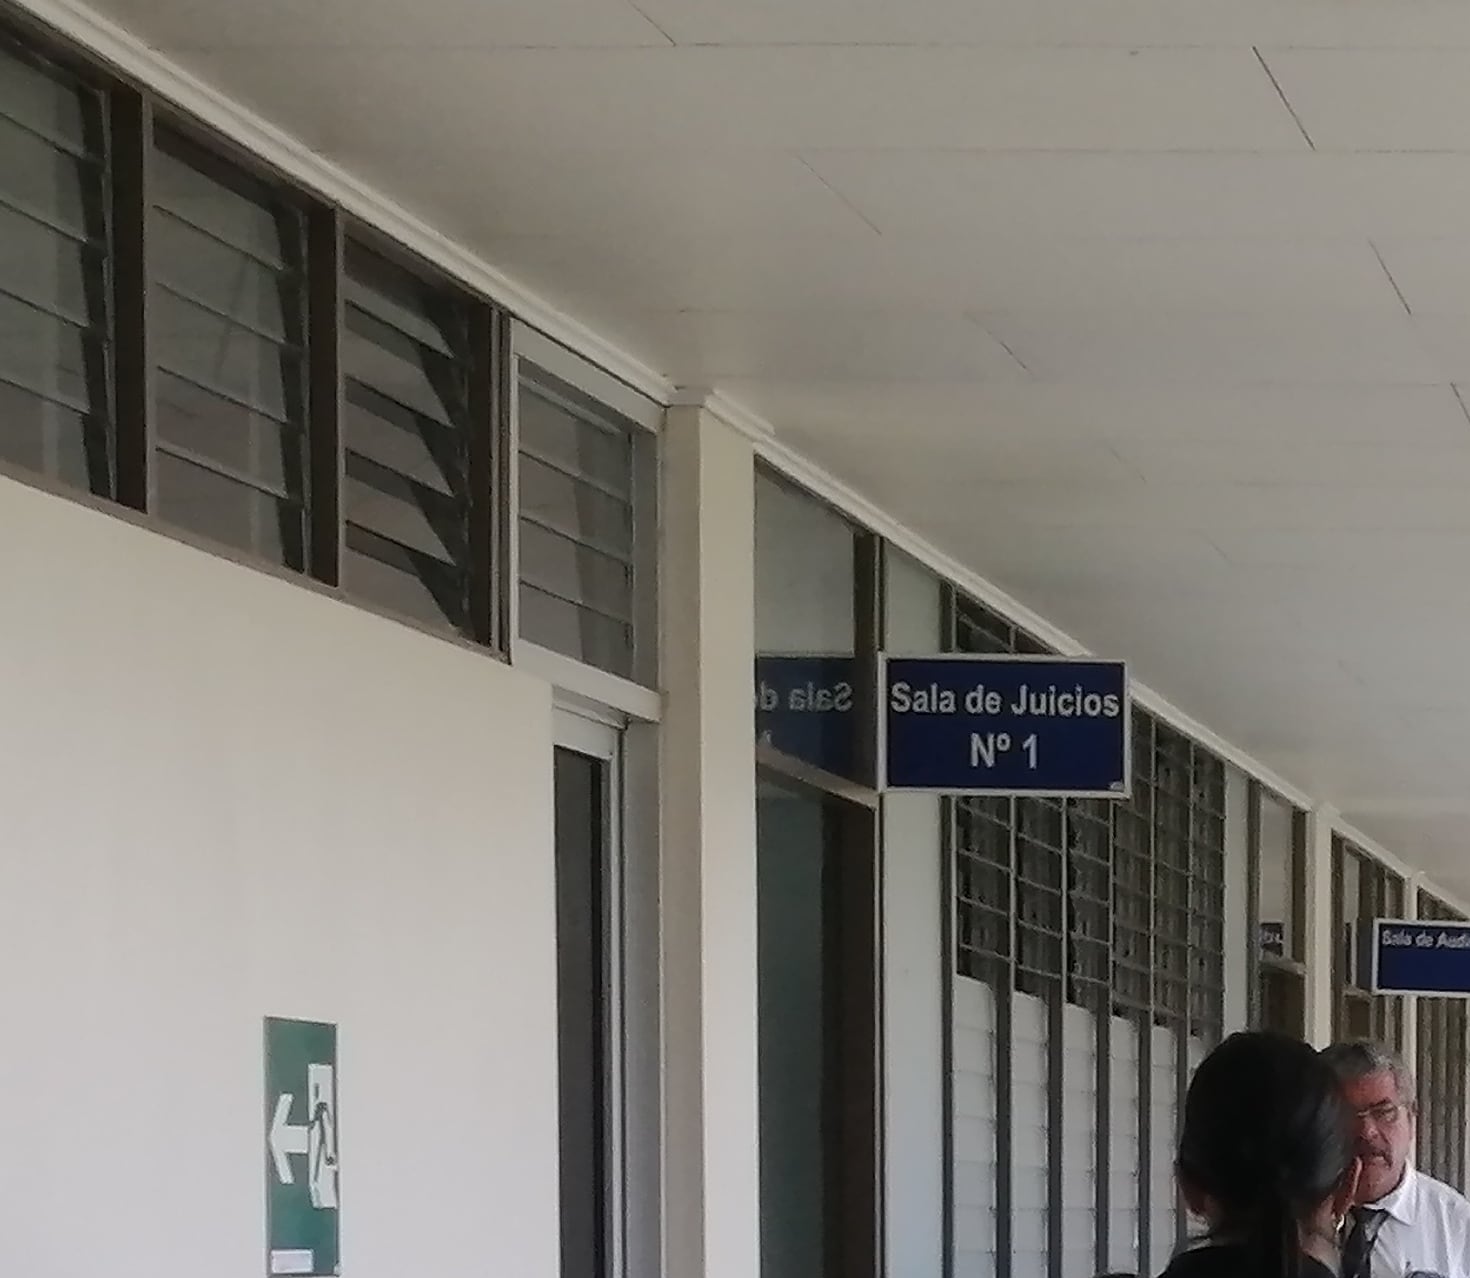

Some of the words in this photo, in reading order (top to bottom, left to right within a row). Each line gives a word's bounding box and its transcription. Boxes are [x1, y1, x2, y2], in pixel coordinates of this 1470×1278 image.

[889, 681, 957, 715] Sala
[964, 684, 1003, 715] de
[1010, 683, 1121, 718] Juicios
[970, 732, 1012, 769] Nº
[1022, 733, 1039, 770] 1
[1415, 930, 1434, 948] de
